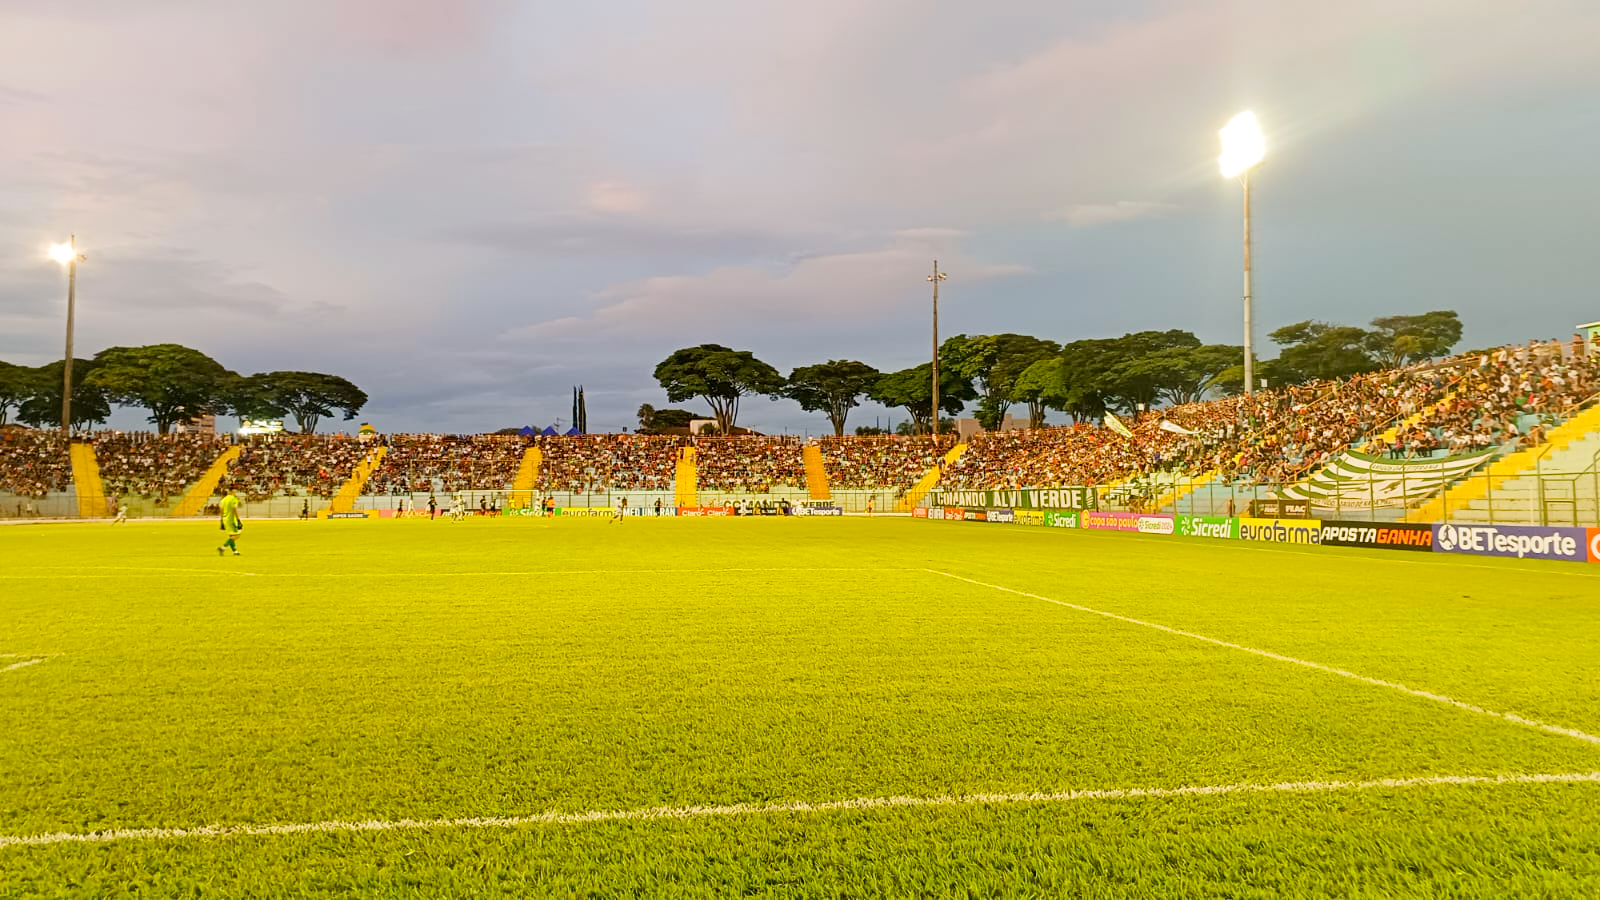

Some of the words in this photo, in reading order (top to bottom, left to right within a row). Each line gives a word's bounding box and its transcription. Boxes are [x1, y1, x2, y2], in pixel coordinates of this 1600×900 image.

[938, 491, 986, 507] COMANDO
[993, 491, 1022, 508] ALVI
[1029, 489, 1082, 509] VERDE
[682, 508, 702, 517] Claro
[707, 508, 727, 517] Claro
[1054, 513, 1077, 528] Sicredi
[1090, 516, 1105, 529] copa
[1106, 514, 1118, 526] são
[1119, 515, 1139, 530] paulo
[1191, 517, 1232, 539] Sicredi
[1240, 520, 1321, 545] eurofarma
[1458, 527, 1576, 559] BETesporte
